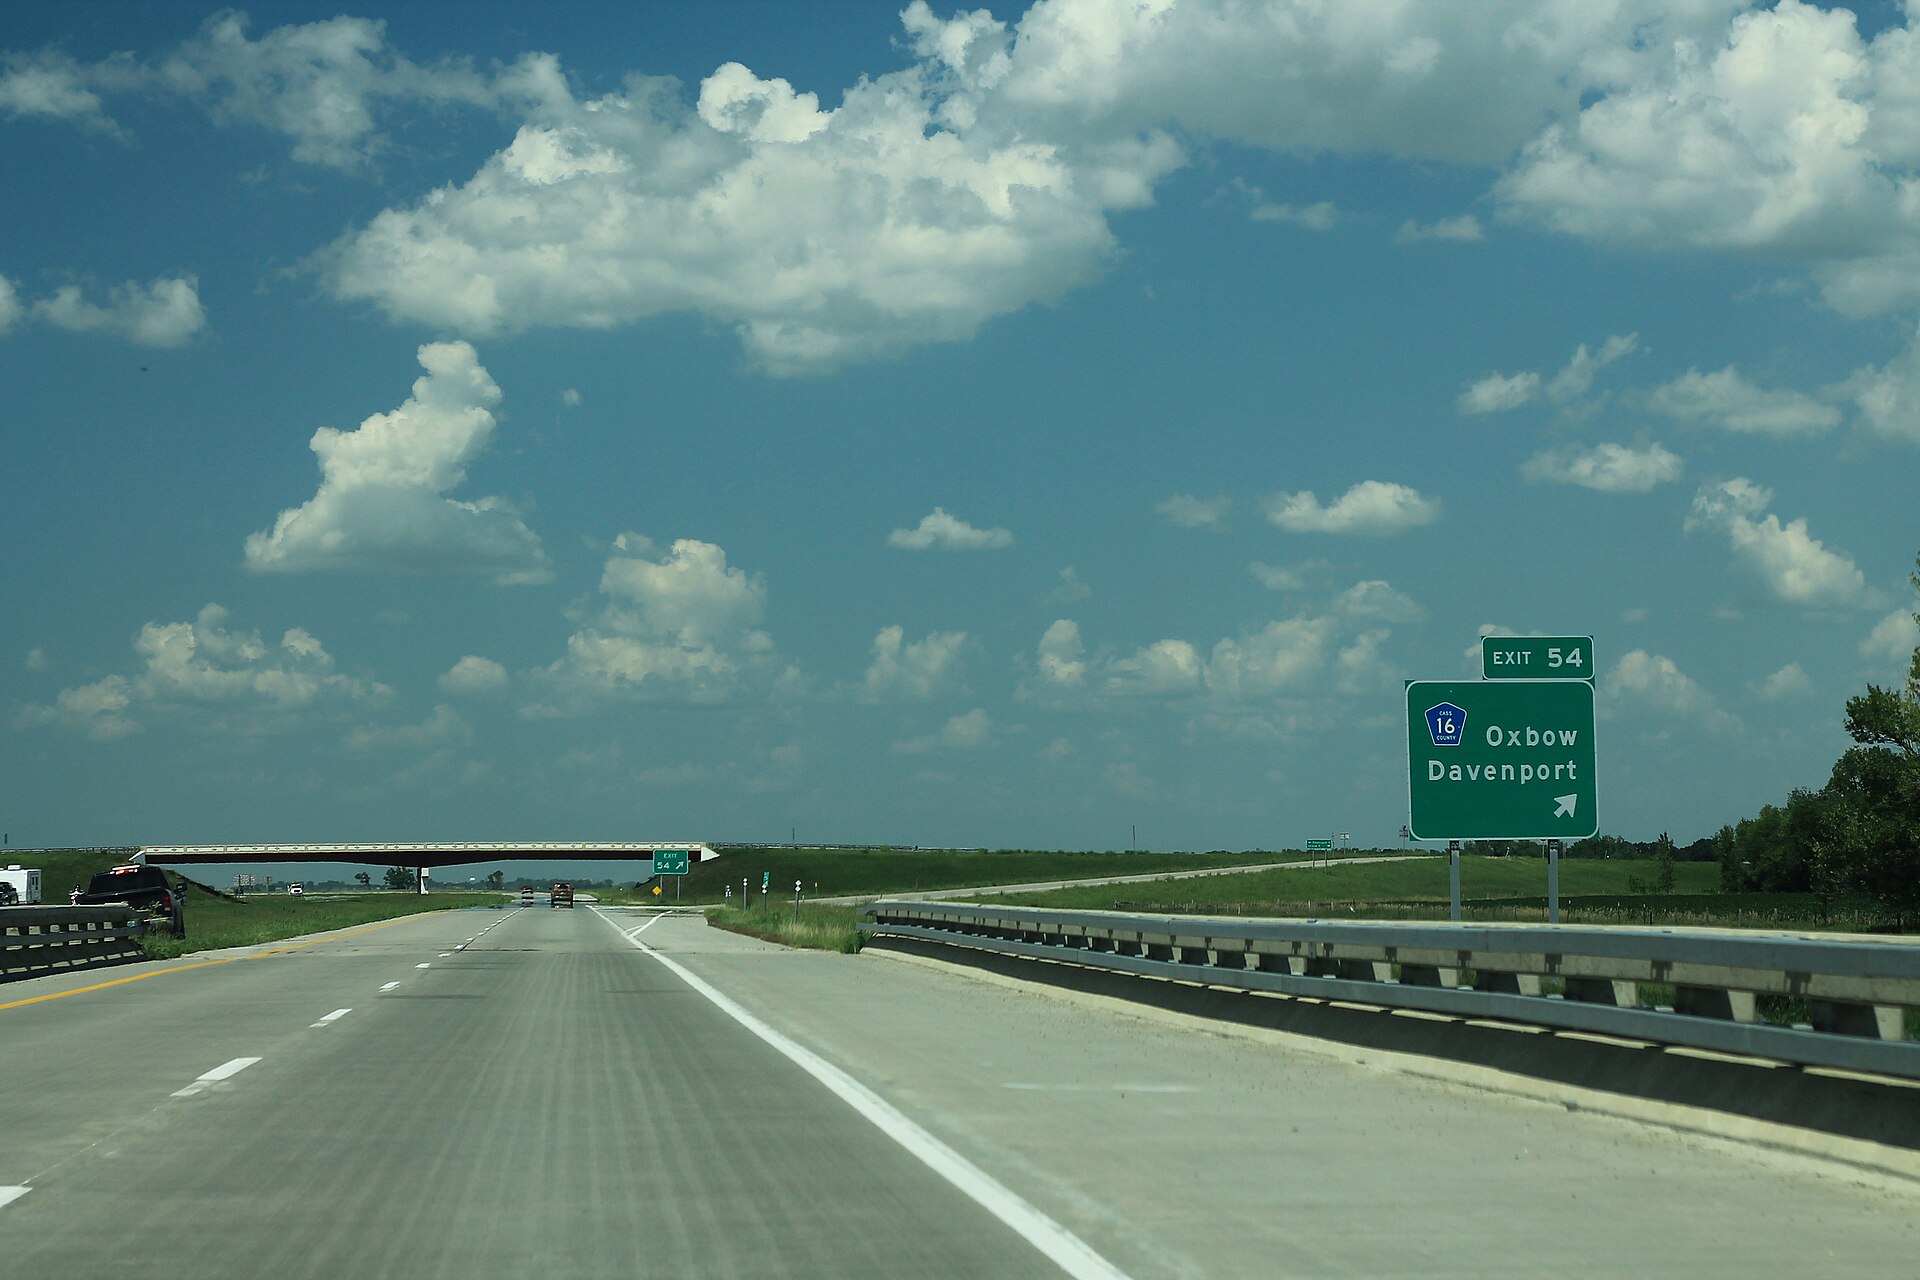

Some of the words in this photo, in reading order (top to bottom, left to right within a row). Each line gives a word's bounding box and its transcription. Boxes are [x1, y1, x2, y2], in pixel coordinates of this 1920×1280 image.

[1493, 651, 1532, 665] EXIT
[1547, 647, 1583, 668] 54
[1436, 717, 1456, 734] 16
[1485, 725, 1578, 747] Oxbow
[1428, 760, 1577, 785] Davenport
[657, 861, 670, 869] 54
